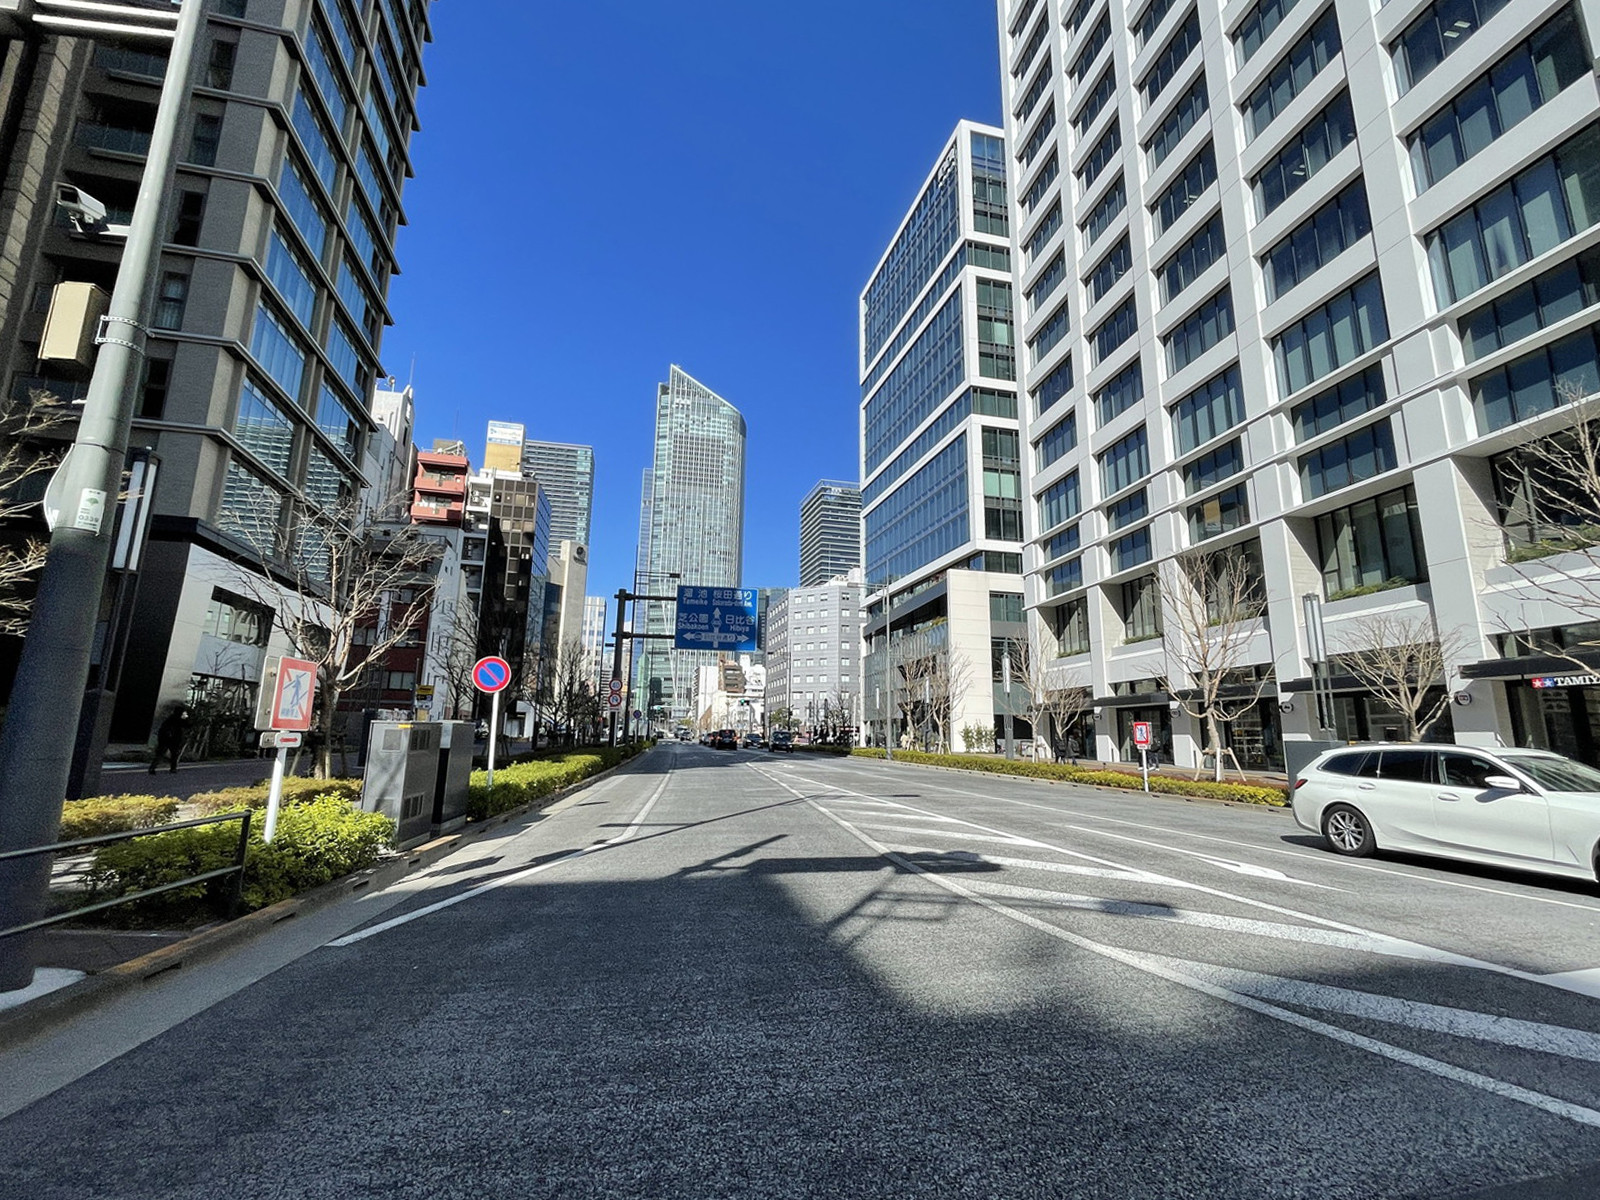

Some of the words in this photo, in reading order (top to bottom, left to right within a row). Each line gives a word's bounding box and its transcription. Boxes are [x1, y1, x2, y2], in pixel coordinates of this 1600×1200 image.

[713, 590, 753, 600] 桜田通り
[683, 598, 708, 606] Tameike
[678, 613, 708, 623] 芝公園
[725, 614, 755, 625] 日比谷
[677, 622, 709, 630] Shibakoen
[730, 625, 750, 633] Hibiya
[1554, 675, 1600, 687] TAMIY
